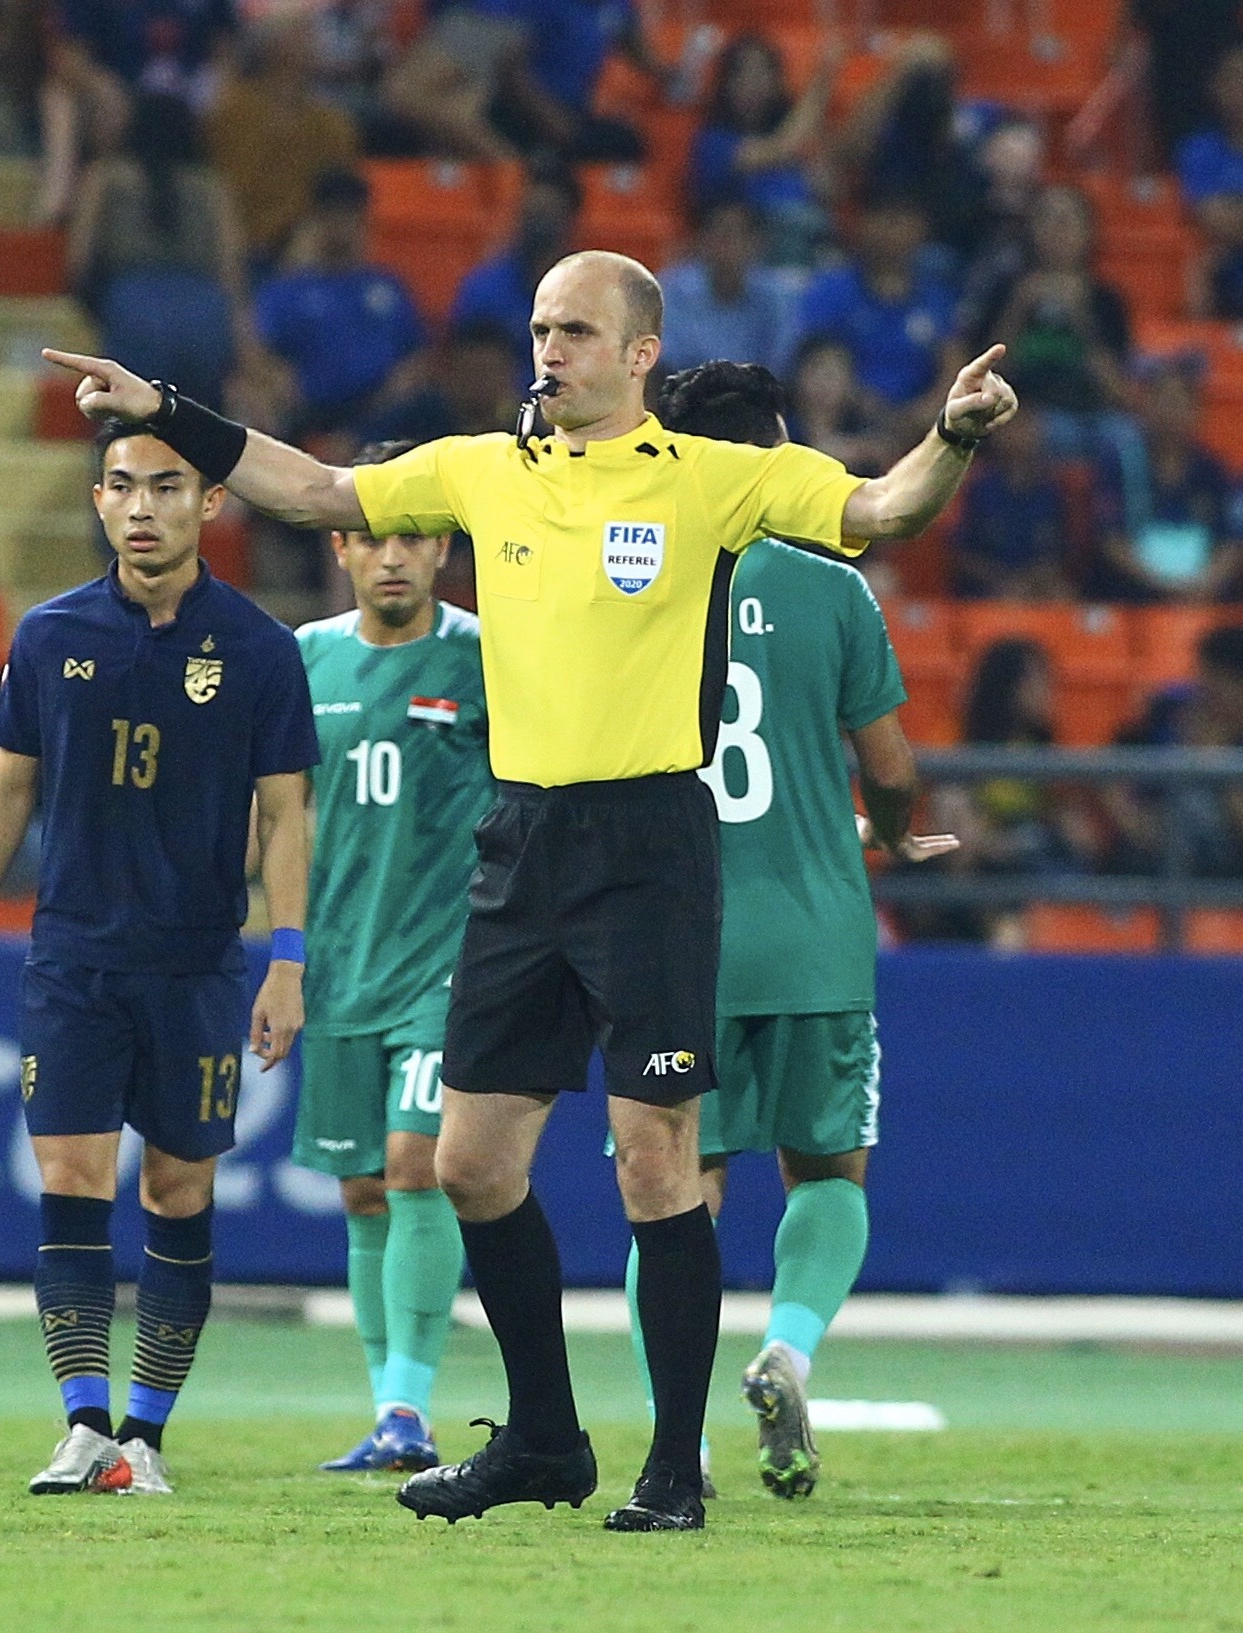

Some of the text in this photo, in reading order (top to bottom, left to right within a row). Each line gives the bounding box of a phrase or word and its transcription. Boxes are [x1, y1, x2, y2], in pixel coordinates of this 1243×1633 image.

[609, 526, 658, 545] FIFA
[608, 554, 657, 566] REFEREE
[619, 579, 643, 589] 2020
[738, 597, 774, 635] Q.
[112, 719, 160, 789] 13
[346, 739, 402, 806] 10
[399, 1048, 444, 1114] 10
[642, 1050, 695, 1076] AFC
[198, 1053, 237, 1123] 13
